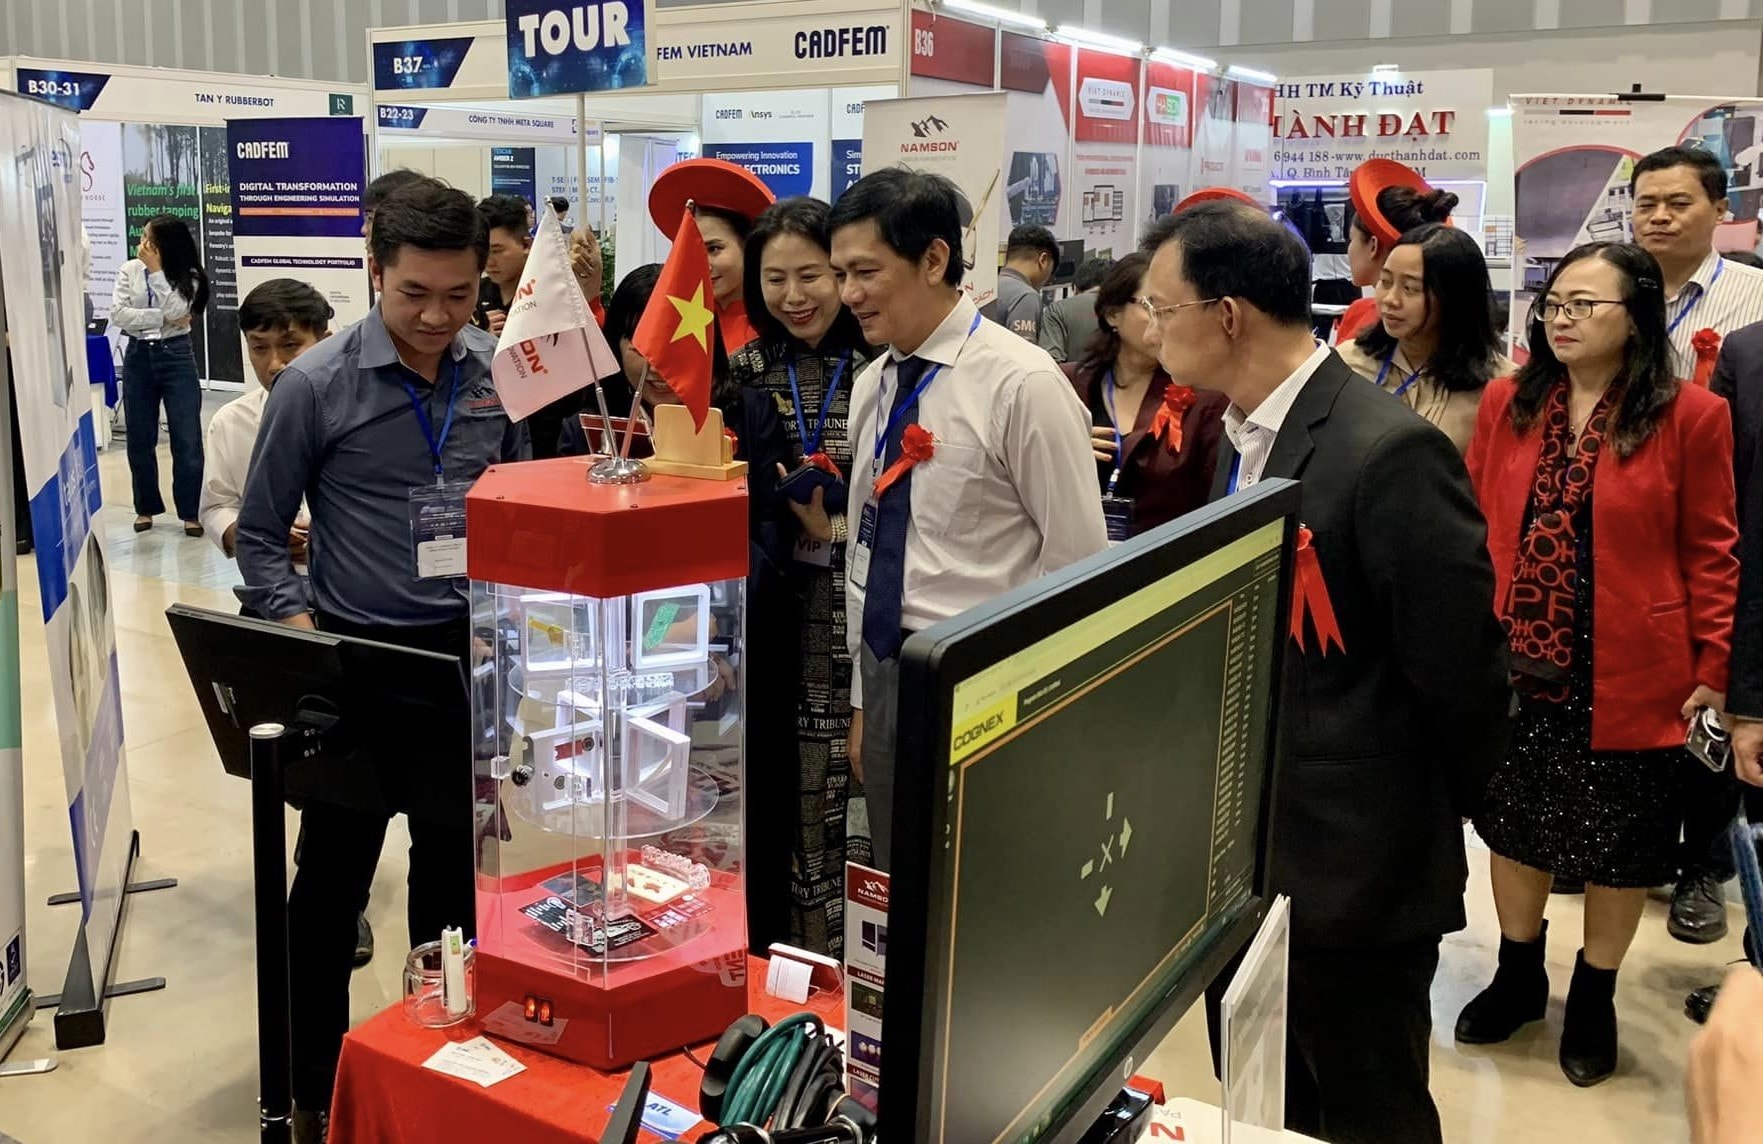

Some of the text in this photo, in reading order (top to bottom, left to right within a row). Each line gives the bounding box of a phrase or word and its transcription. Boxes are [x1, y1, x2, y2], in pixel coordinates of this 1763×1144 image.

[518, 1, 631, 58] TOUR
[794, 26, 888, 59] CADFEM
[914, 28, 934, 57] B36
[687, 42, 753, 59] VIETNAM
[393, 56, 423, 75] B37
[28, 79, 81, 97] B30-31
[1306, 83, 1334, 98] TM
[1340, 81, 1364, 99] Kỹ
[1369, 80, 1425, 98] Thuật
[195, 93, 274, 107] TAN Y RUBBERBOT
[380, 107, 414, 121] B22-23
[468, 114, 554, 129] CÔNG TY TNHH META SQUARE
[716, 109, 742, 119] CADFEM
[1376, 111, 1457, 142] ĐẠT
[237, 142, 289, 159] CADFEM
[901, 142, 957, 152] NAMSON
[715, 151, 798, 161] Empowering Innovation
[1283, 152, 1304, 162] 944
[739, 164, 801, 175] ECTRONICS
[1304, 167, 1331, 178] Bình
[1335, 166, 1351, 178] Tâ
[127, 183, 196, 198] Vietnam's first
[240, 182, 358, 191] DIGITAL TRANSFORMATION
[128, 204, 160, 216] rubber
[953, 711, 1005, 751] COGNEX
[646, 1102, 672, 1117] ATL
